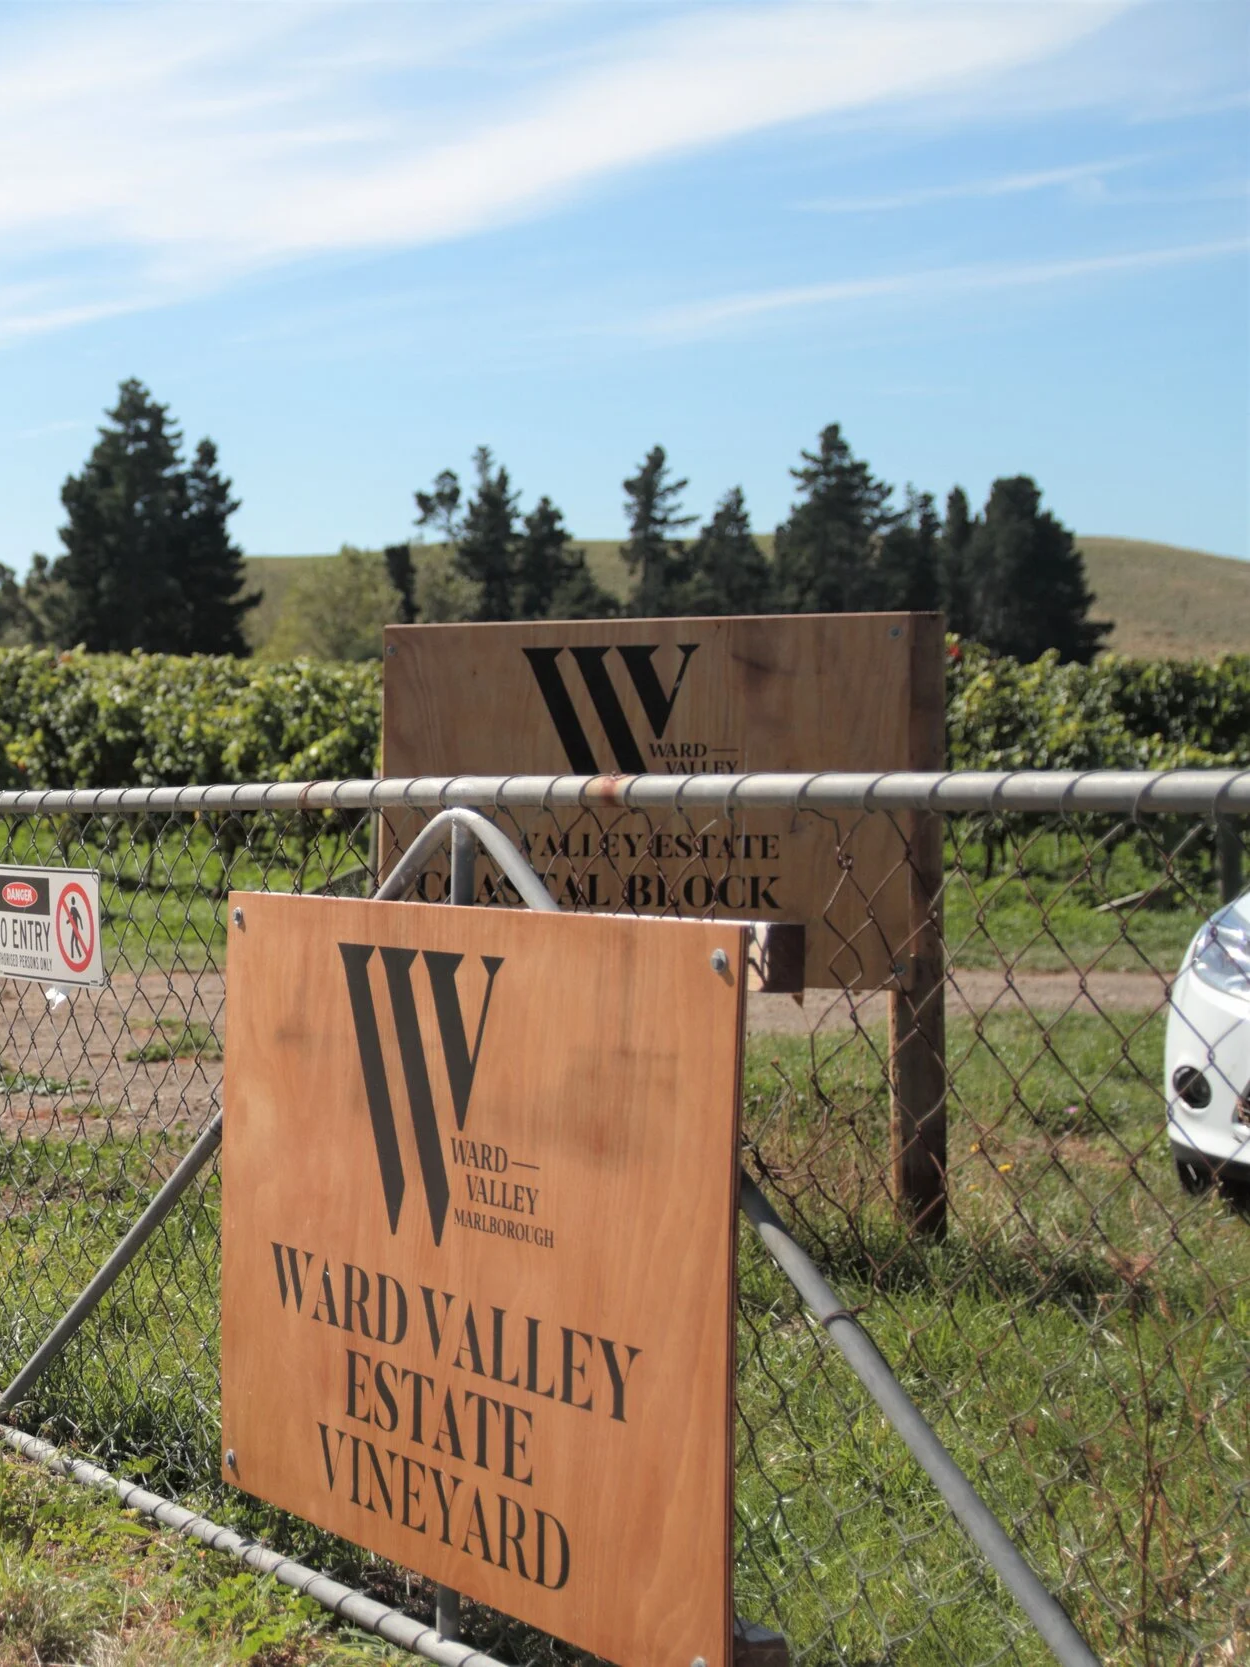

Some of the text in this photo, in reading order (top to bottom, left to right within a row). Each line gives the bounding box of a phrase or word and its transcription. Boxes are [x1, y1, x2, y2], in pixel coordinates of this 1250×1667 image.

[649, 743, 707, 758] WARD
[665, 760, 738, 774] VALLEY
[650, 834, 779, 859] ESTATE
[6, 887, 33, 902] DANGER
[416, 871, 781, 909] CASTAL BLOCK
[12, 919, 50, 952] ENTRY
[19, 954, 39, 970] PERSONS
[40, 957, 52, 971] ONLY
[450, 1137, 508, 1173] WARD
[466, 1174, 540, 1215] VALLEY
[454, 1207, 554, 1249] MARLBOROUGH
[271, 1241, 643, 1423] WARD VALLEY
[345, 1348, 533, 1487] ESTATE
[316, 1421, 570, 1591] VINEYARD
